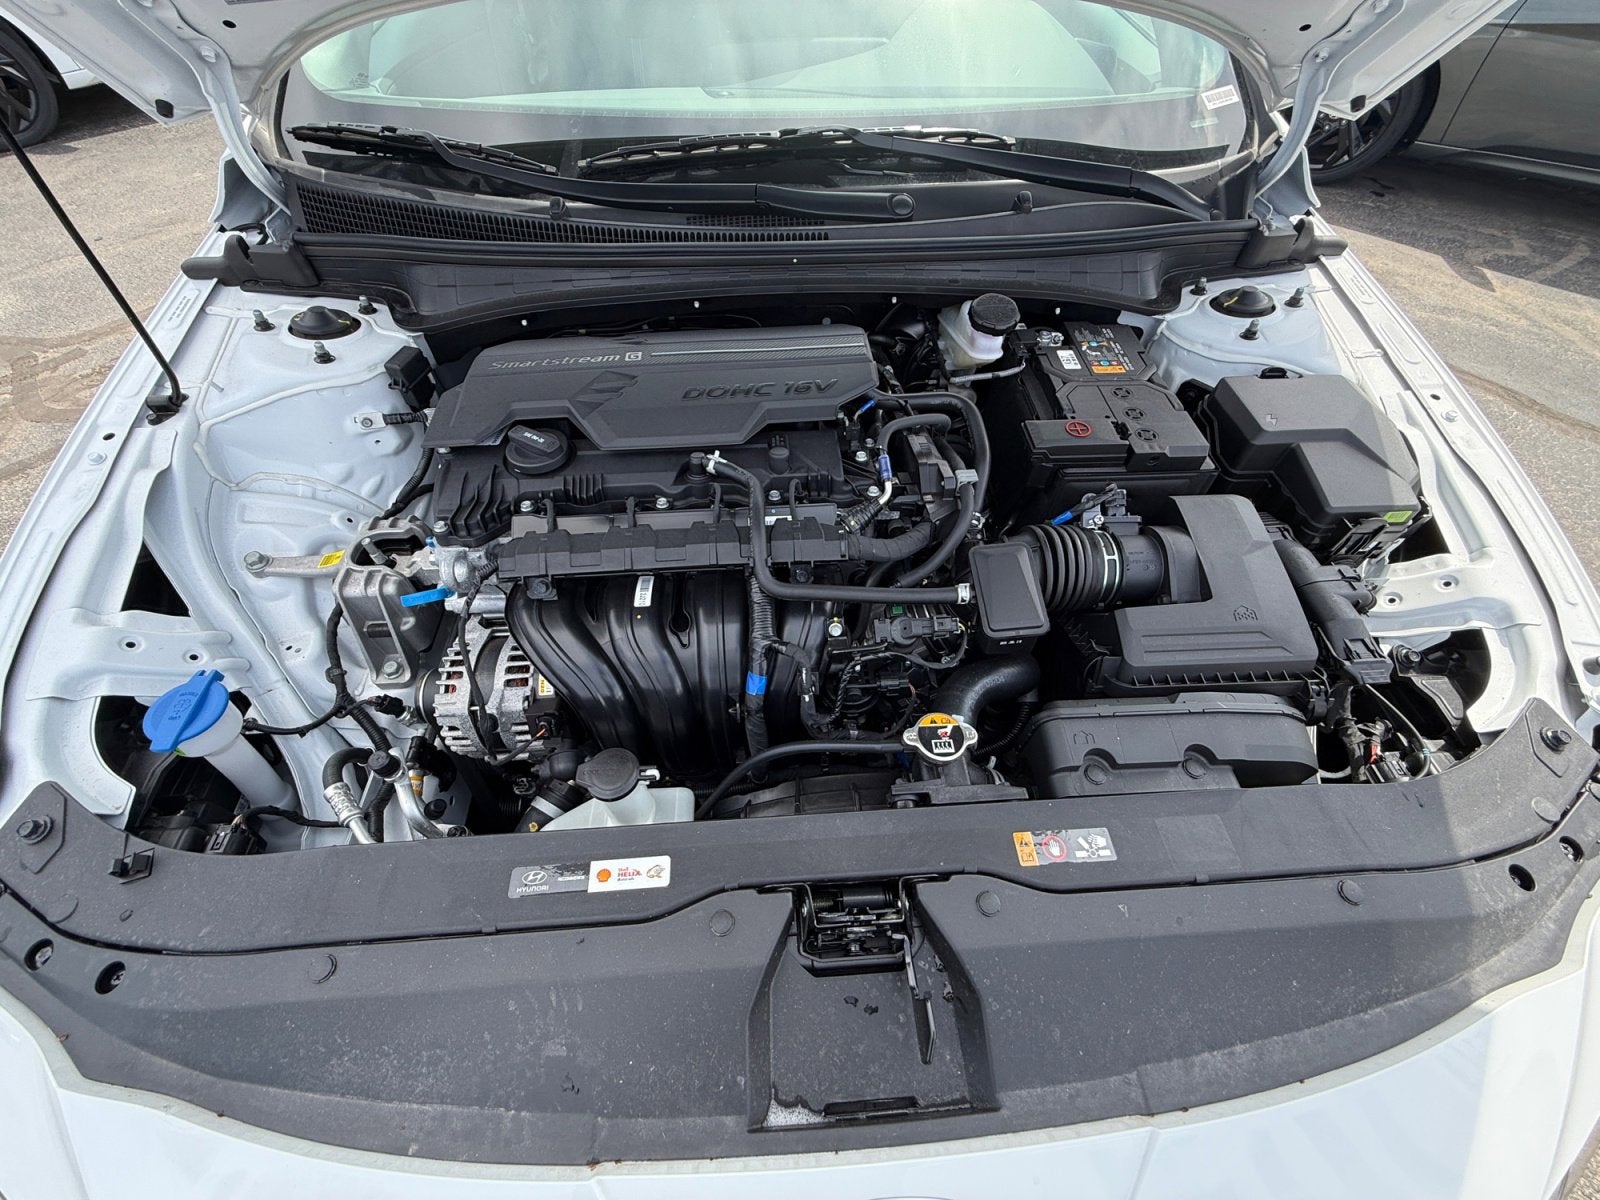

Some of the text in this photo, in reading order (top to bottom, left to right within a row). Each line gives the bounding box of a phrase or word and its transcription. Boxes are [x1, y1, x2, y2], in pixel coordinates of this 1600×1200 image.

[488, 354, 620, 370] Smartstream
[682, 379, 838, 399] DOHC 16V
[617, 869, 641, 877] HELIX
[516, 885, 549, 893] HYUNDAI
